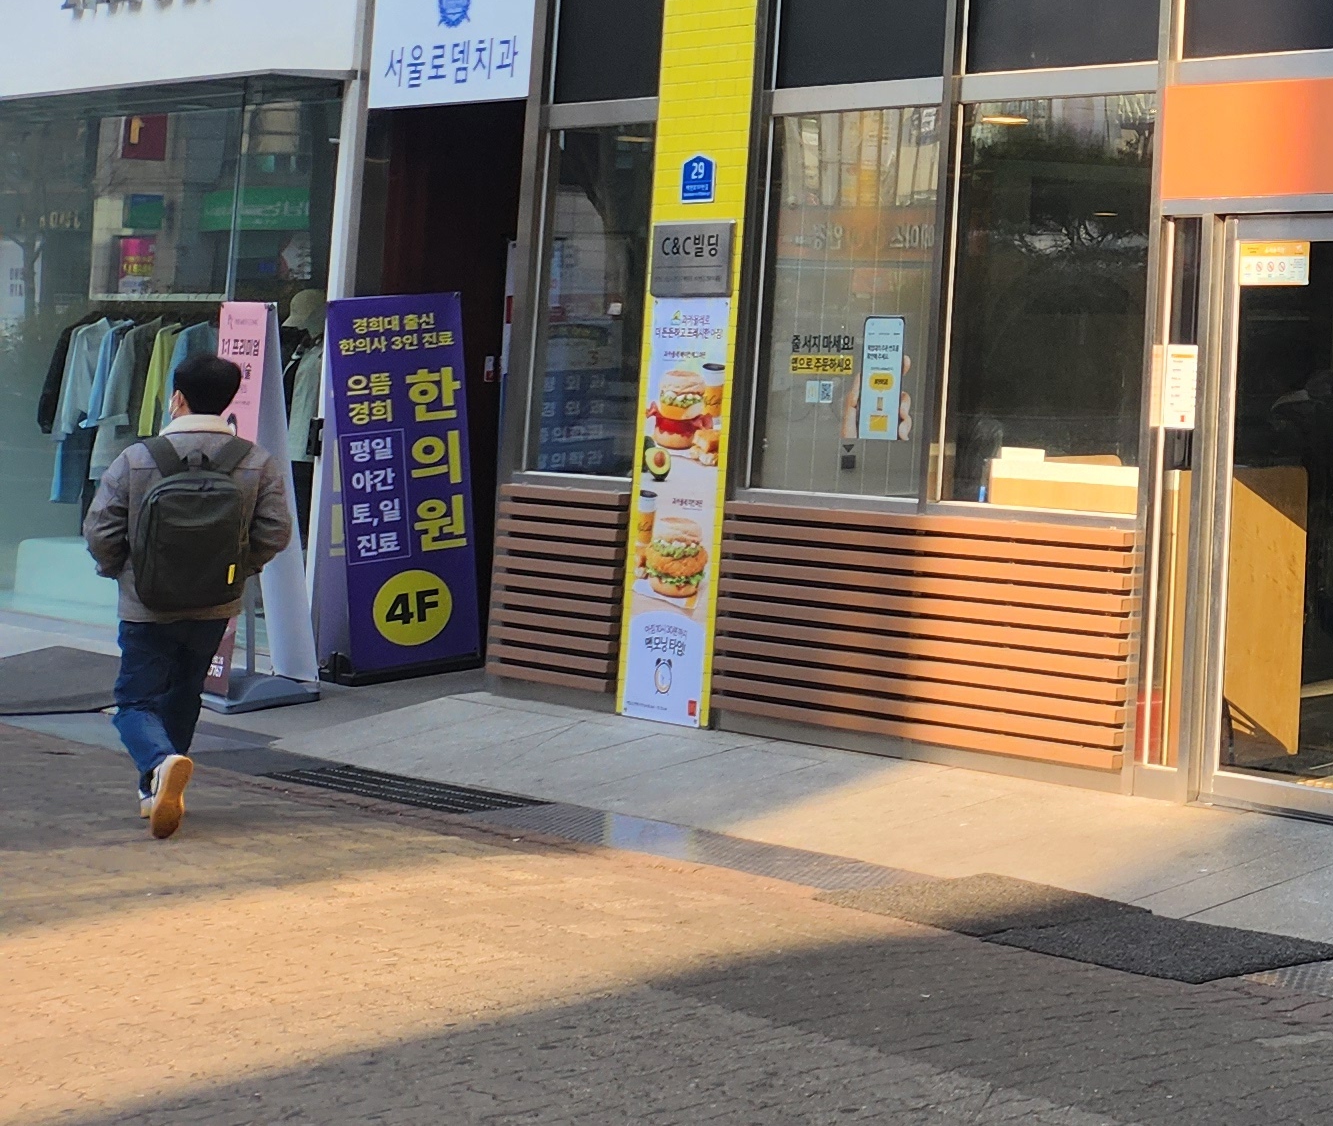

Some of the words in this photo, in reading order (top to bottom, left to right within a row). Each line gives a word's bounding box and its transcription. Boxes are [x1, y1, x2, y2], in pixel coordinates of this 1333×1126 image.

[384, 35, 519, 89] 서울로뎀치과
[691, 162, 705, 179] 29
[662, 234, 719, 258] C&C빌딩
[353, 315, 399, 335] 경희대
[404, 313, 436, 331] 출신
[339, 335, 387, 356] 한의사
[391, 334, 419, 351] 3인
[422, 331, 455, 349] 진료
[791, 334, 801, 352] 줄
[802, 334, 821, 353] 서지
[822, 334, 854, 353] 마세요!
[814, 357, 852, 372] 주문하세요
[346, 372, 392, 396] 으뜸
[348, 400, 393, 425] 경희
[349, 436, 394, 462] 평일
[405, 366, 468, 552] 한의원
[352, 468, 396, 493] 야간
[356, 532, 401, 557] 진료
[385, 589, 440, 625] 4F
[645, 637, 669, 654] 맥모닝
